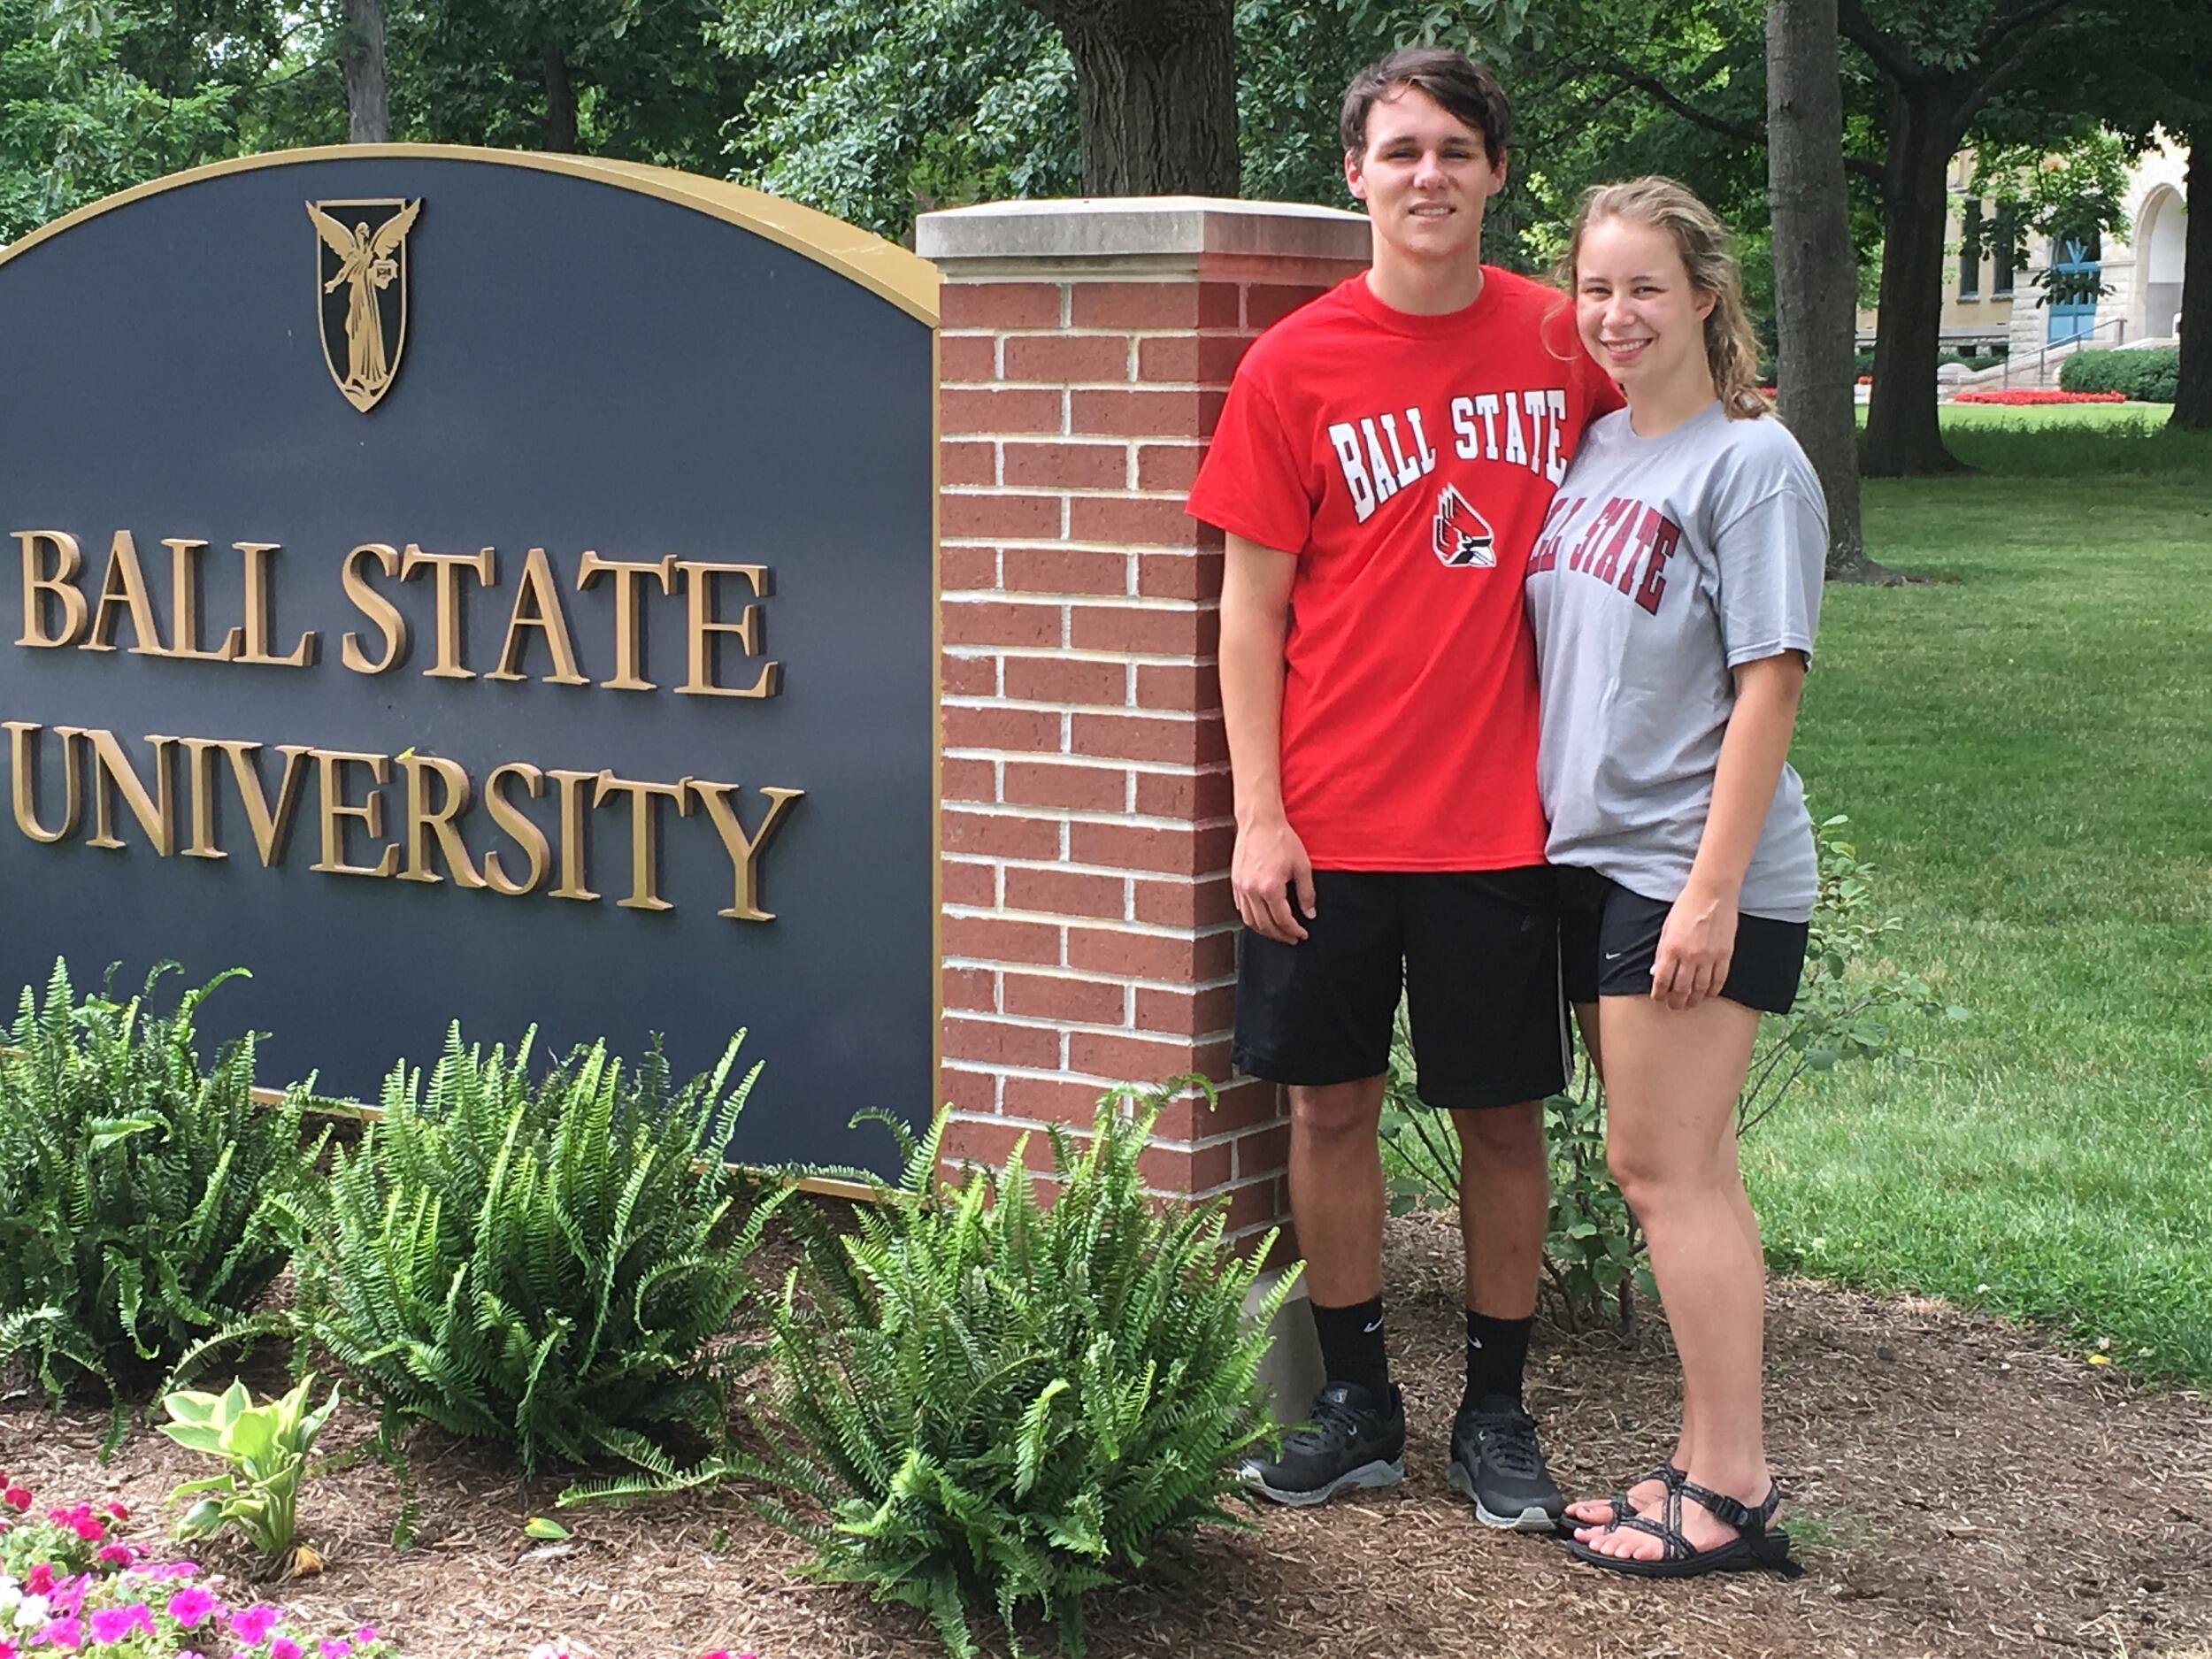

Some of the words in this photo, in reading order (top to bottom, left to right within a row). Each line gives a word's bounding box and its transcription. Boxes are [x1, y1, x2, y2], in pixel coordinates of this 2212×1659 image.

[1328, 407, 1436, 524] BALL
[1450, 389, 1567, 488] STATE
[11, 530, 317, 668] BALL
[342, 543, 780, 699] STATE
[1569, 496, 1681, 617] STATE
[2, 721, 806, 923] UNIVERSITY
